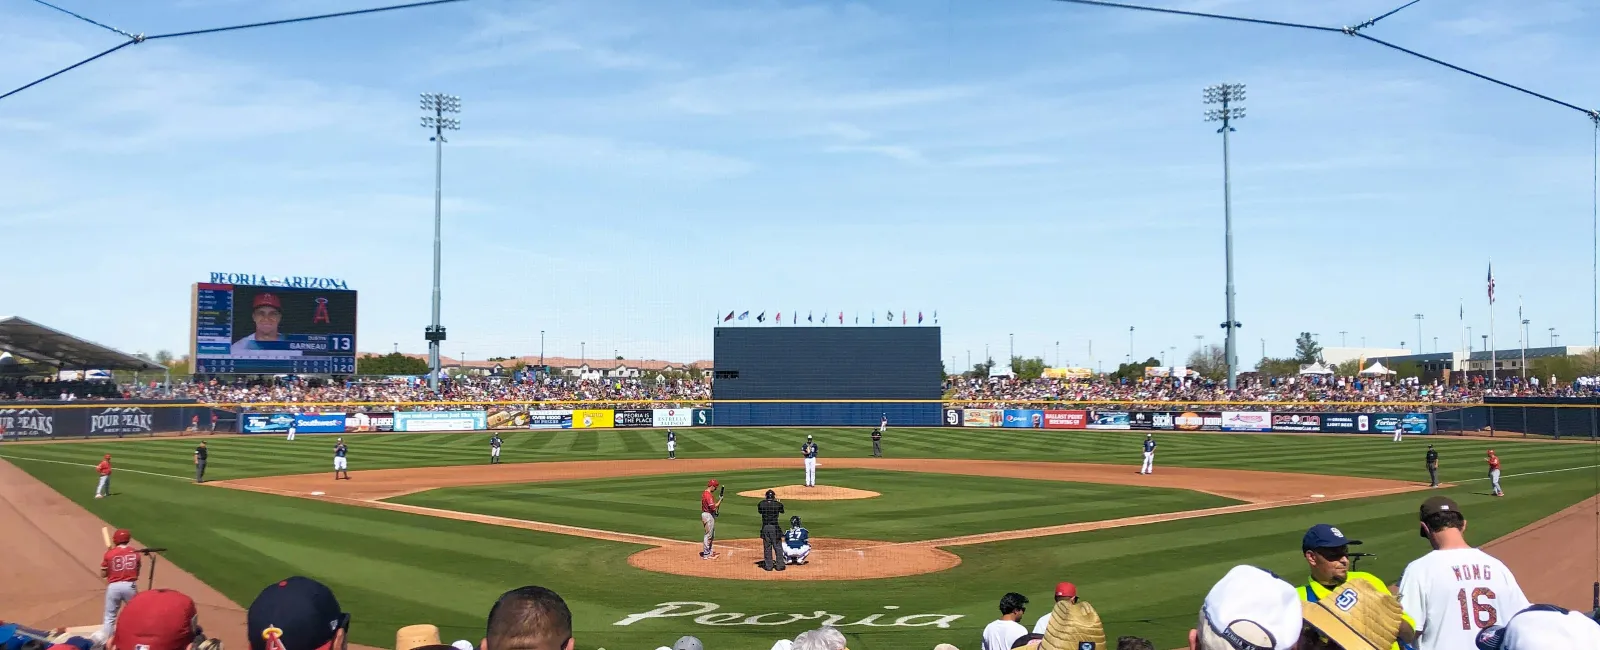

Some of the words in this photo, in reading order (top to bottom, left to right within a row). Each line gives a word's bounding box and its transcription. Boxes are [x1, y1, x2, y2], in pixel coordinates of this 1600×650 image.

[210, 272, 268, 286] PEORIA
[281, 276, 349, 290] ARIZONA
[289, 342, 327, 350] GARNEAU
[332, 337, 351, 350] 13
[90, 415, 120, 432] FOUR
[298, 418, 338, 427] Southwest
[112, 554, 137, 571] 85
[1451, 564, 1491, 581] WONG
[612, 601, 965, 628] Peoria
[1457, 586, 1497, 630] 16
